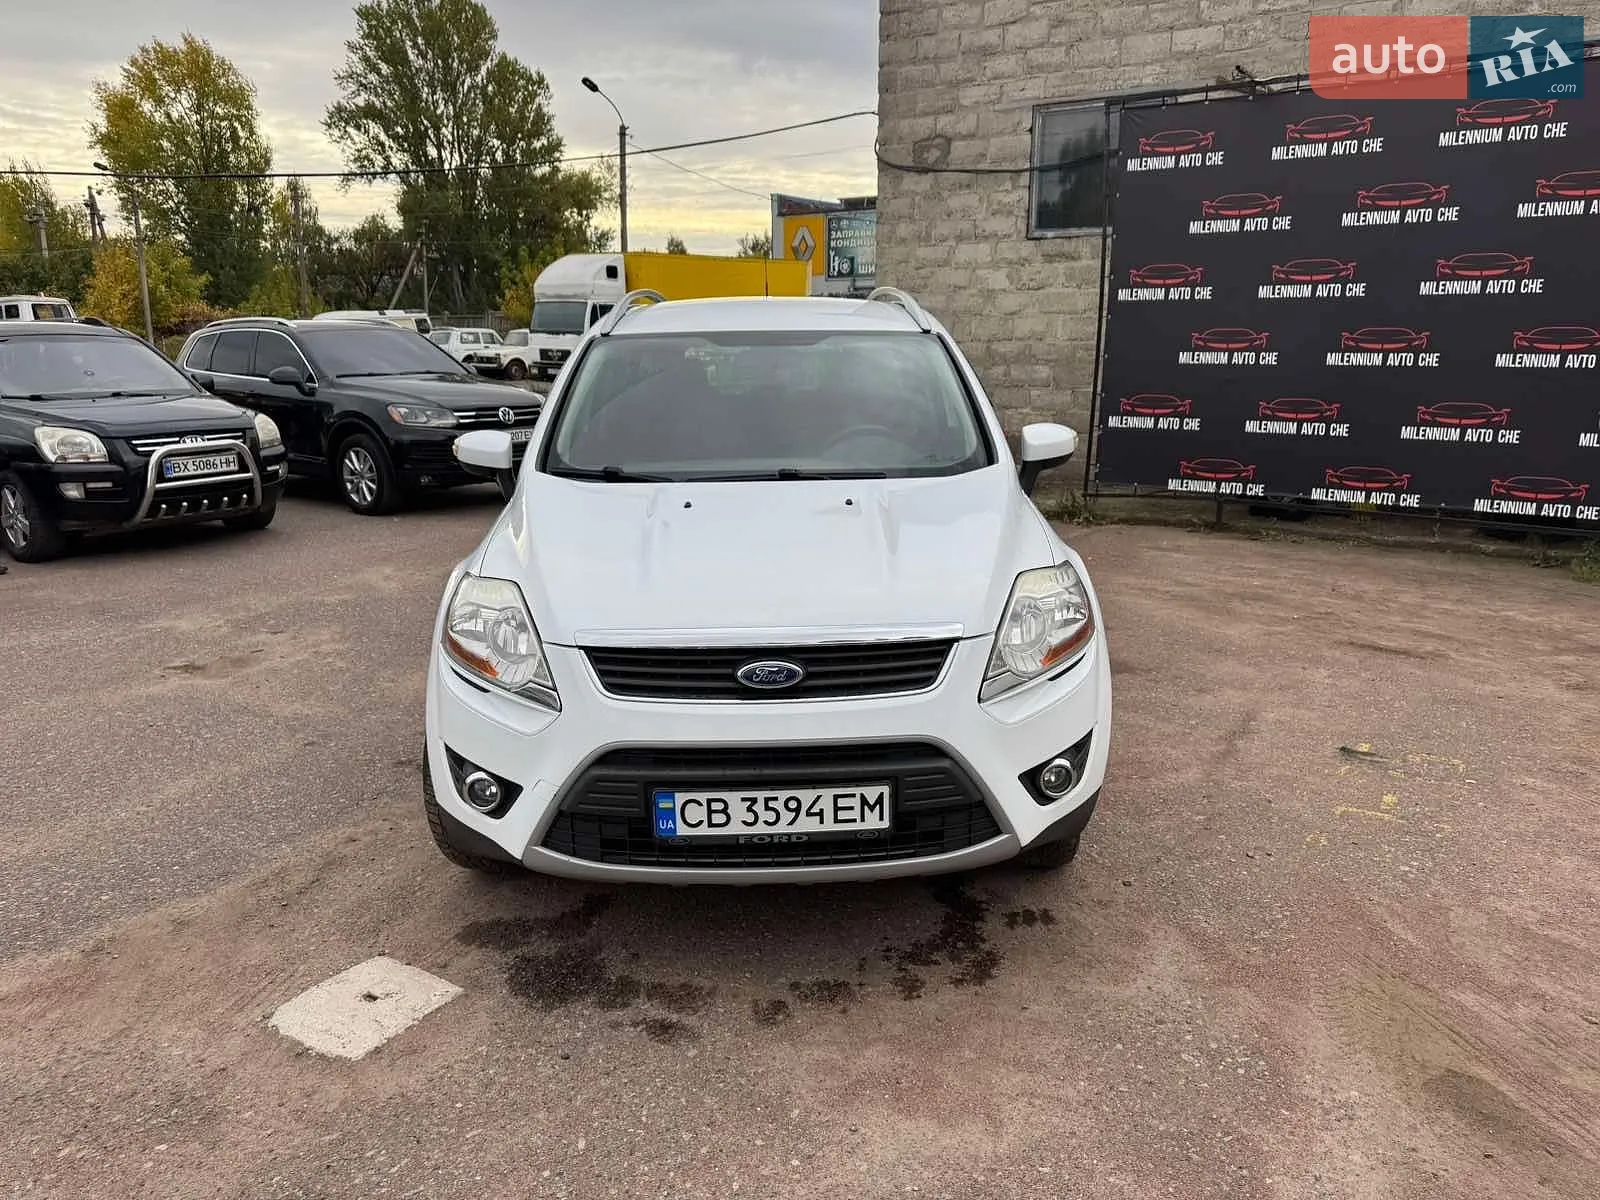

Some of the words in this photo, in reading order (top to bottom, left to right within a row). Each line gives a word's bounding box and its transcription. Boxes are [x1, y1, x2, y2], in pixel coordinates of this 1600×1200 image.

[1438, 127, 1504, 148] MILENNIUM
[1506, 124, 1539, 142] AVTO
[1543, 121, 1569, 139] CHE
[1271, 142, 1328, 161] MILENNIUM
[1330, 139, 1359, 156] AVTO
[1362, 137, 1384, 153] CHE
[1126, 156, 1176, 172] MILENNIUM
[1178, 152, 1202, 168] AVTO
[1205, 151, 1225, 166] CHE
[1341, 209, 1401, 227] MILENNIUM
[1403, 207, 1433, 224] AVTO
[1437, 206, 1461, 222] CHE
[1516, 199, 1585, 218] MILENNIUM
[1188, 218, 1241, 235] MILENNIUM
[1243, 217, 1269, 232] AVTO
[1272, 215, 1292, 231] CHE
[858, 263, 876, 274] ШИ
[1117, 287, 1165, 301] MILENNIUM
[1168, 286, 1192, 301] AVTO
[1194, 286, 1213, 300] CHE
[1257, 284, 1313, 299] MILENNIUM
[1315, 283, 1342, 298] AVTO
[1345, 282, 1367, 297] CHE
[1419, 279, 1482, 296] MILENNIUM
[1485, 279, 1516, 294] AVTO
[1520, 278, 1545, 294] CHE
[1178, 351, 1229, 365] MILENNIUM
[1231, 351, 1256, 365] AVTO
[1259, 351, 1279, 365] CHE
[1326, 352, 1383, 367] MILENNIUM
[1386, 352, 1415, 367] AVTO
[1418, 352, 1441, 367] CHE
[1495, 353, 1561, 368] MILENNIUM
[1564, 353, 1597, 369] AVTO
[1107, 415, 1155, 429] MILENNIUM
[1157, 416, 1180, 430] AVTO
[1182, 417, 1201, 431] CHE
[1244, 420, 1298, 435] MILENNIUM
[1300, 422, 1326, 436] AVTO
[1329, 423, 1350, 437] CHE
[510, 431, 523, 441] 207
[1400, 425, 1461, 441] MILENNIUM
[1463, 428, 1494, 443] AVTO
[1497, 429, 1521, 444] CHE
[1578, 432, 1600, 448] MIL
[172, 461, 191, 474] BX
[192, 459, 218, 472] 5086
[219, 455, 237, 469] HH
[1167, 478, 1217, 493] MILENNIUM
[1219, 481, 1243, 495] AVTO
[1246, 483, 1265, 497] CHE
[1310, 487, 1366, 504] MILENNIUM
[1368, 491, 1396, 506] AVTO
[1399, 493, 1421, 508] CHE
[1473, 498, 1537, 516] MILENNIUM
[1540, 503, 1572, 518] AVTO
[1575, 505, 1600, 521] CHE
[752, 666, 788, 682] Ford
[679, 797, 732, 829] CB
[740, 793, 826, 827] 3594
[832, 791, 885, 825] EM
[659, 819, 675, 830] UA
[738, 835, 809, 845] FORD
